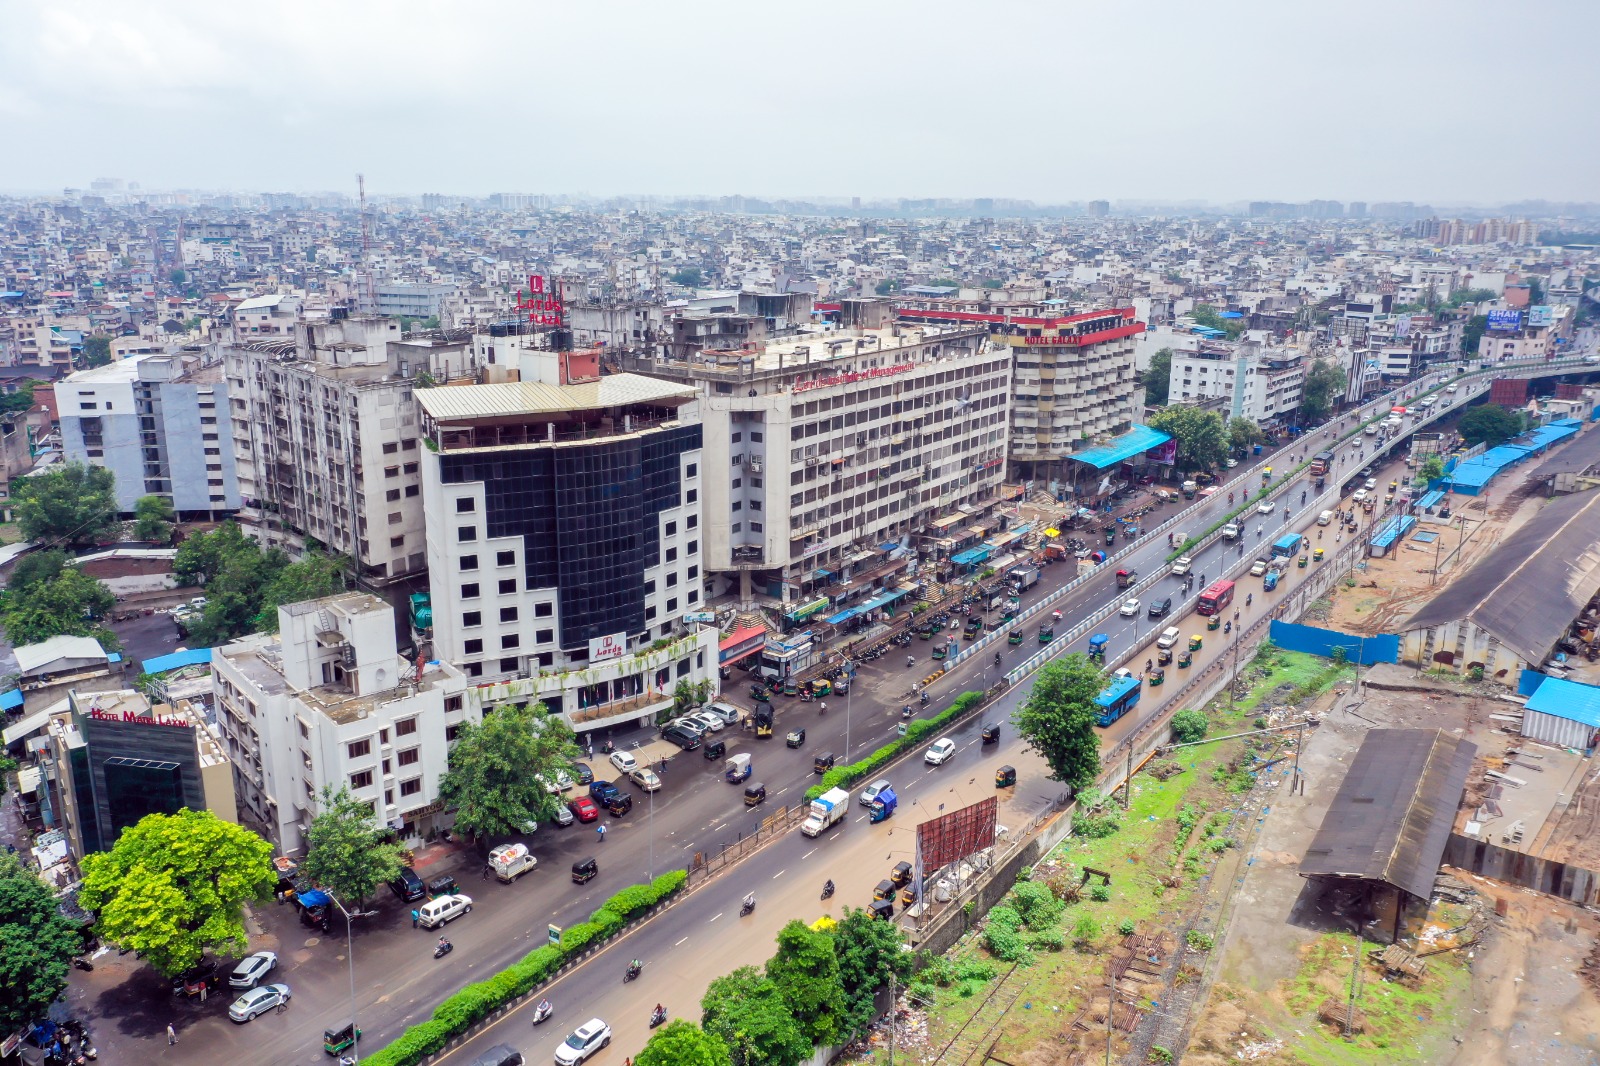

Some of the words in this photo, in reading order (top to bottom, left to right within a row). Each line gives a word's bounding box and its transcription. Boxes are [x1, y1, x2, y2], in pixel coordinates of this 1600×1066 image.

[514, 289, 561, 314] Lords
[529, 313, 560, 325] PLAZA
[1490, 310, 1519, 318] SHAH
[1024, 336, 1049, 345] HOTEL
[1052, 336, 1082, 345] GALAXY
[870, 362, 916, 378] Management
[595, 644, 622, 658] Lords
